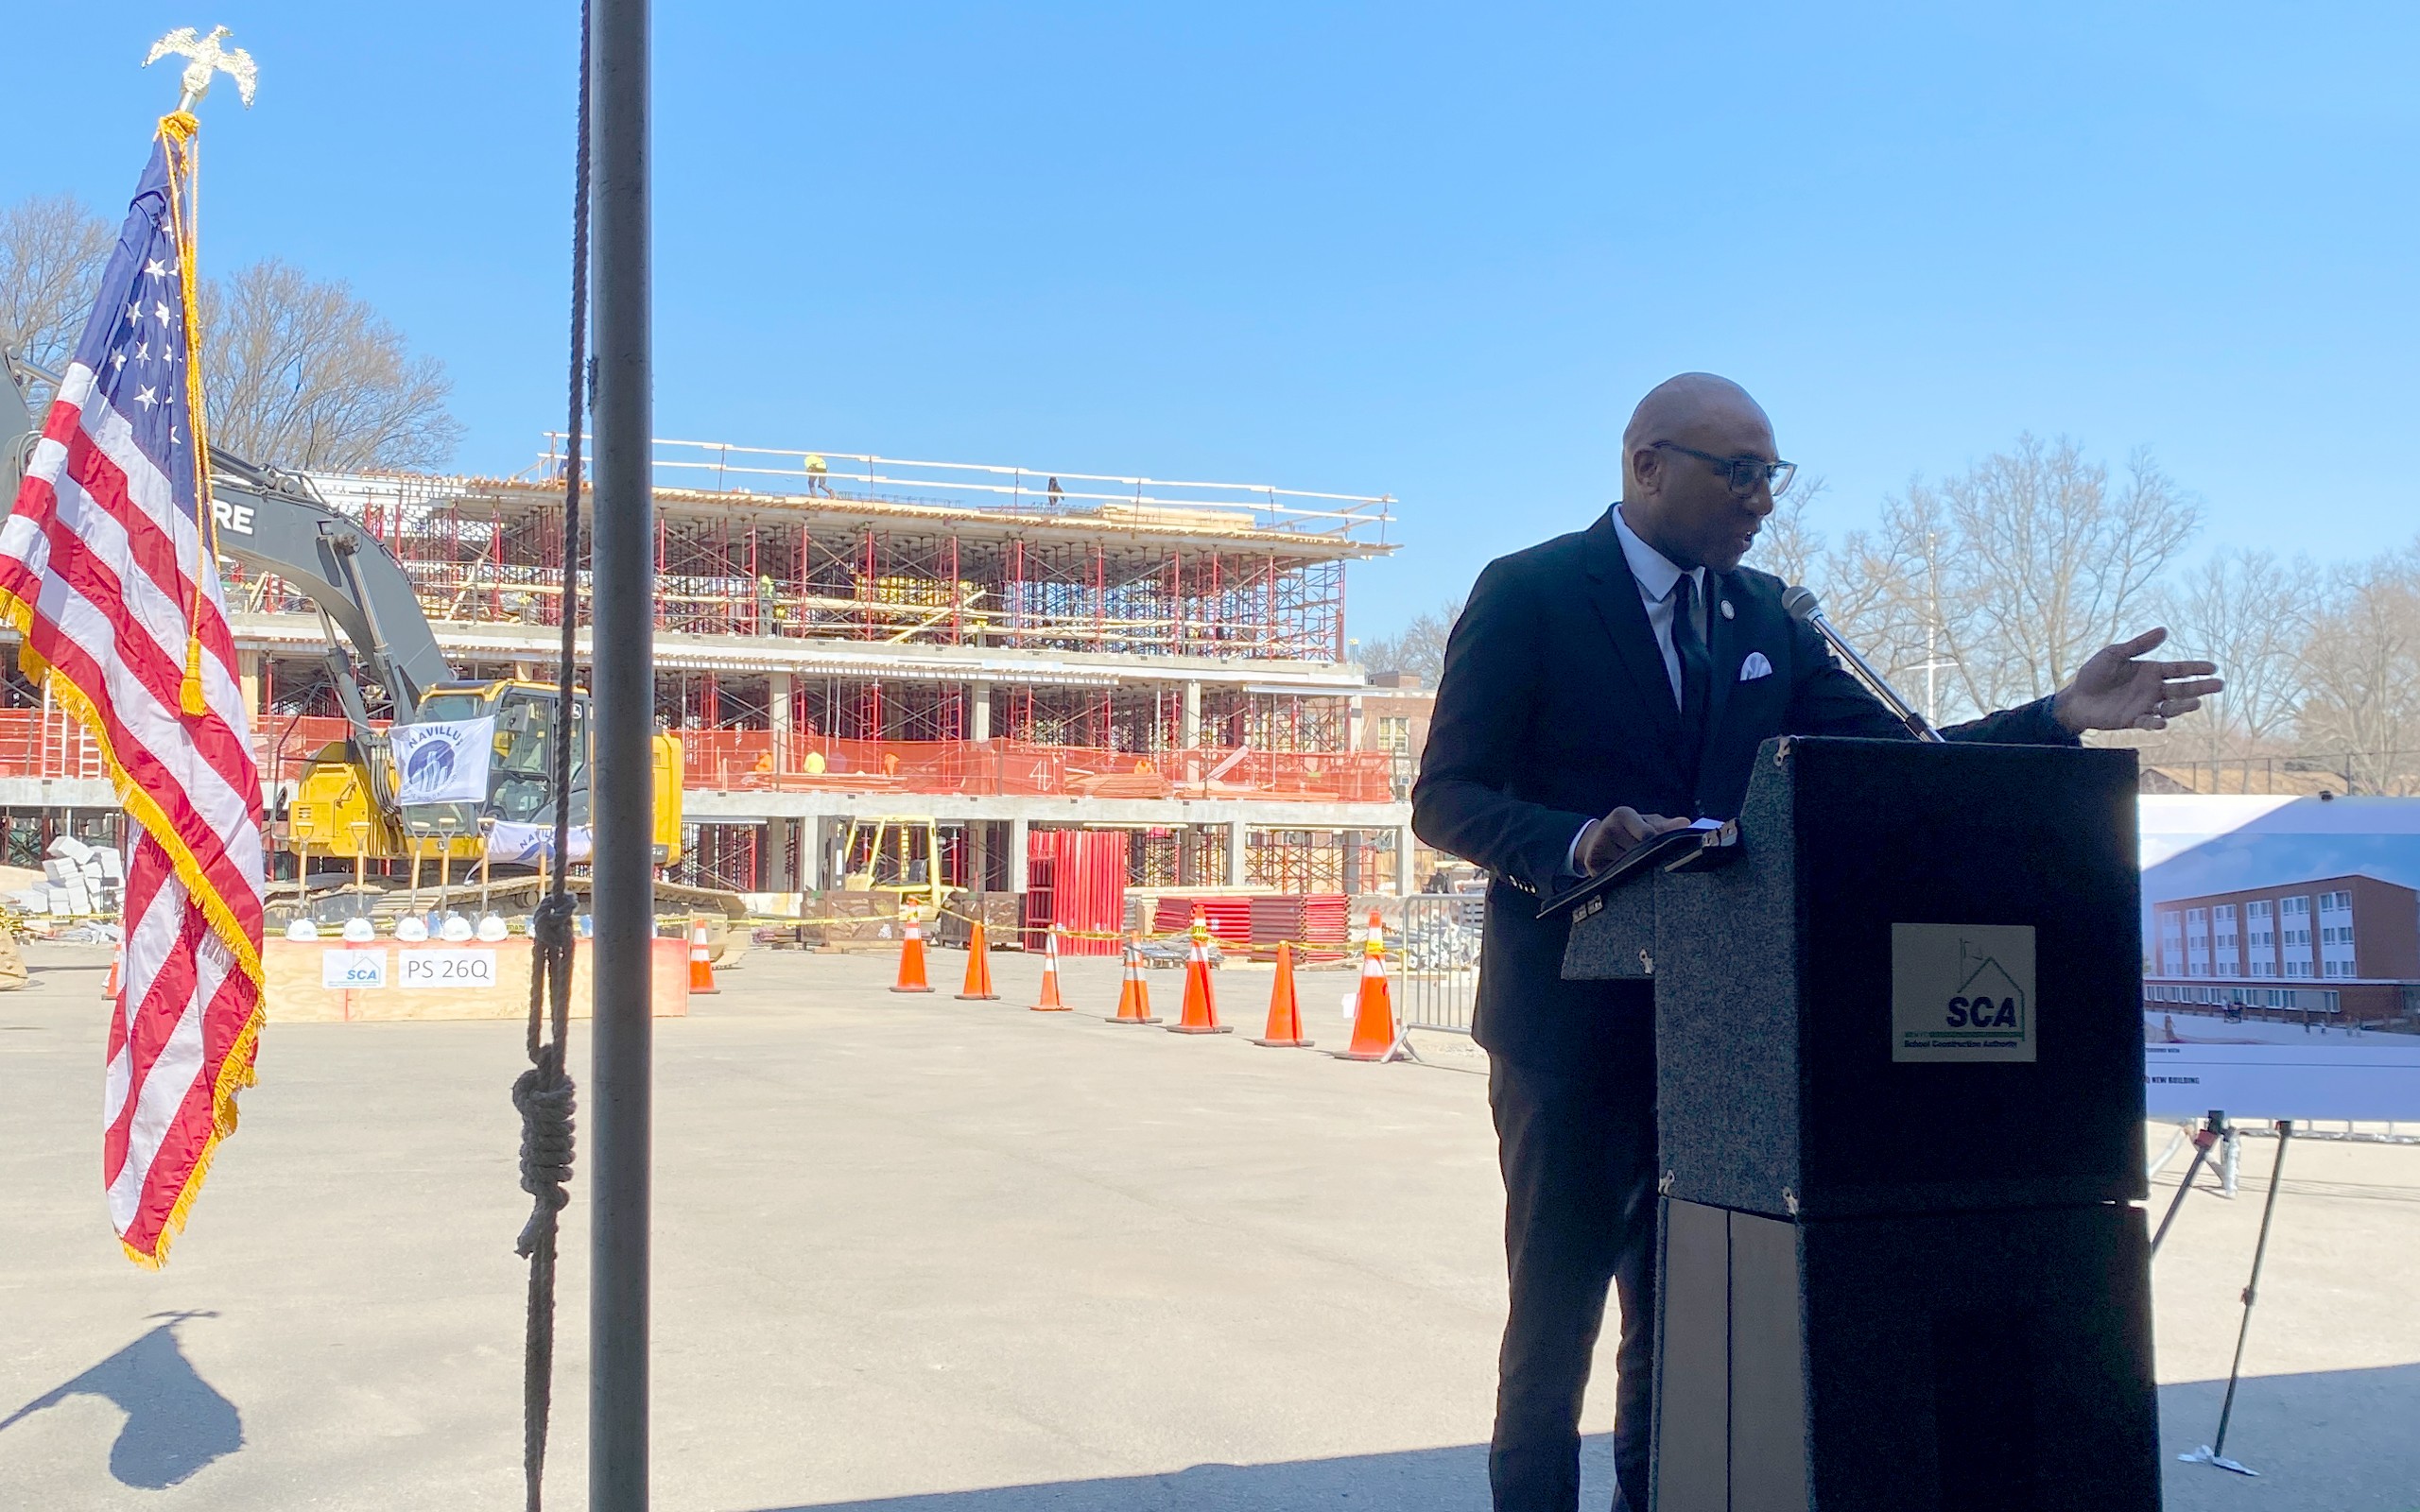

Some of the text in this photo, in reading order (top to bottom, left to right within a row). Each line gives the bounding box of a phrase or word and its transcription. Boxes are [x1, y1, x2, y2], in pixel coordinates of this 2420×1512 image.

[212, 498, 255, 535] RE
[346, 970, 377, 980] SCA
[408, 959, 490, 980] PS 26Q
[1946, 996, 2017, 1028] SCA
